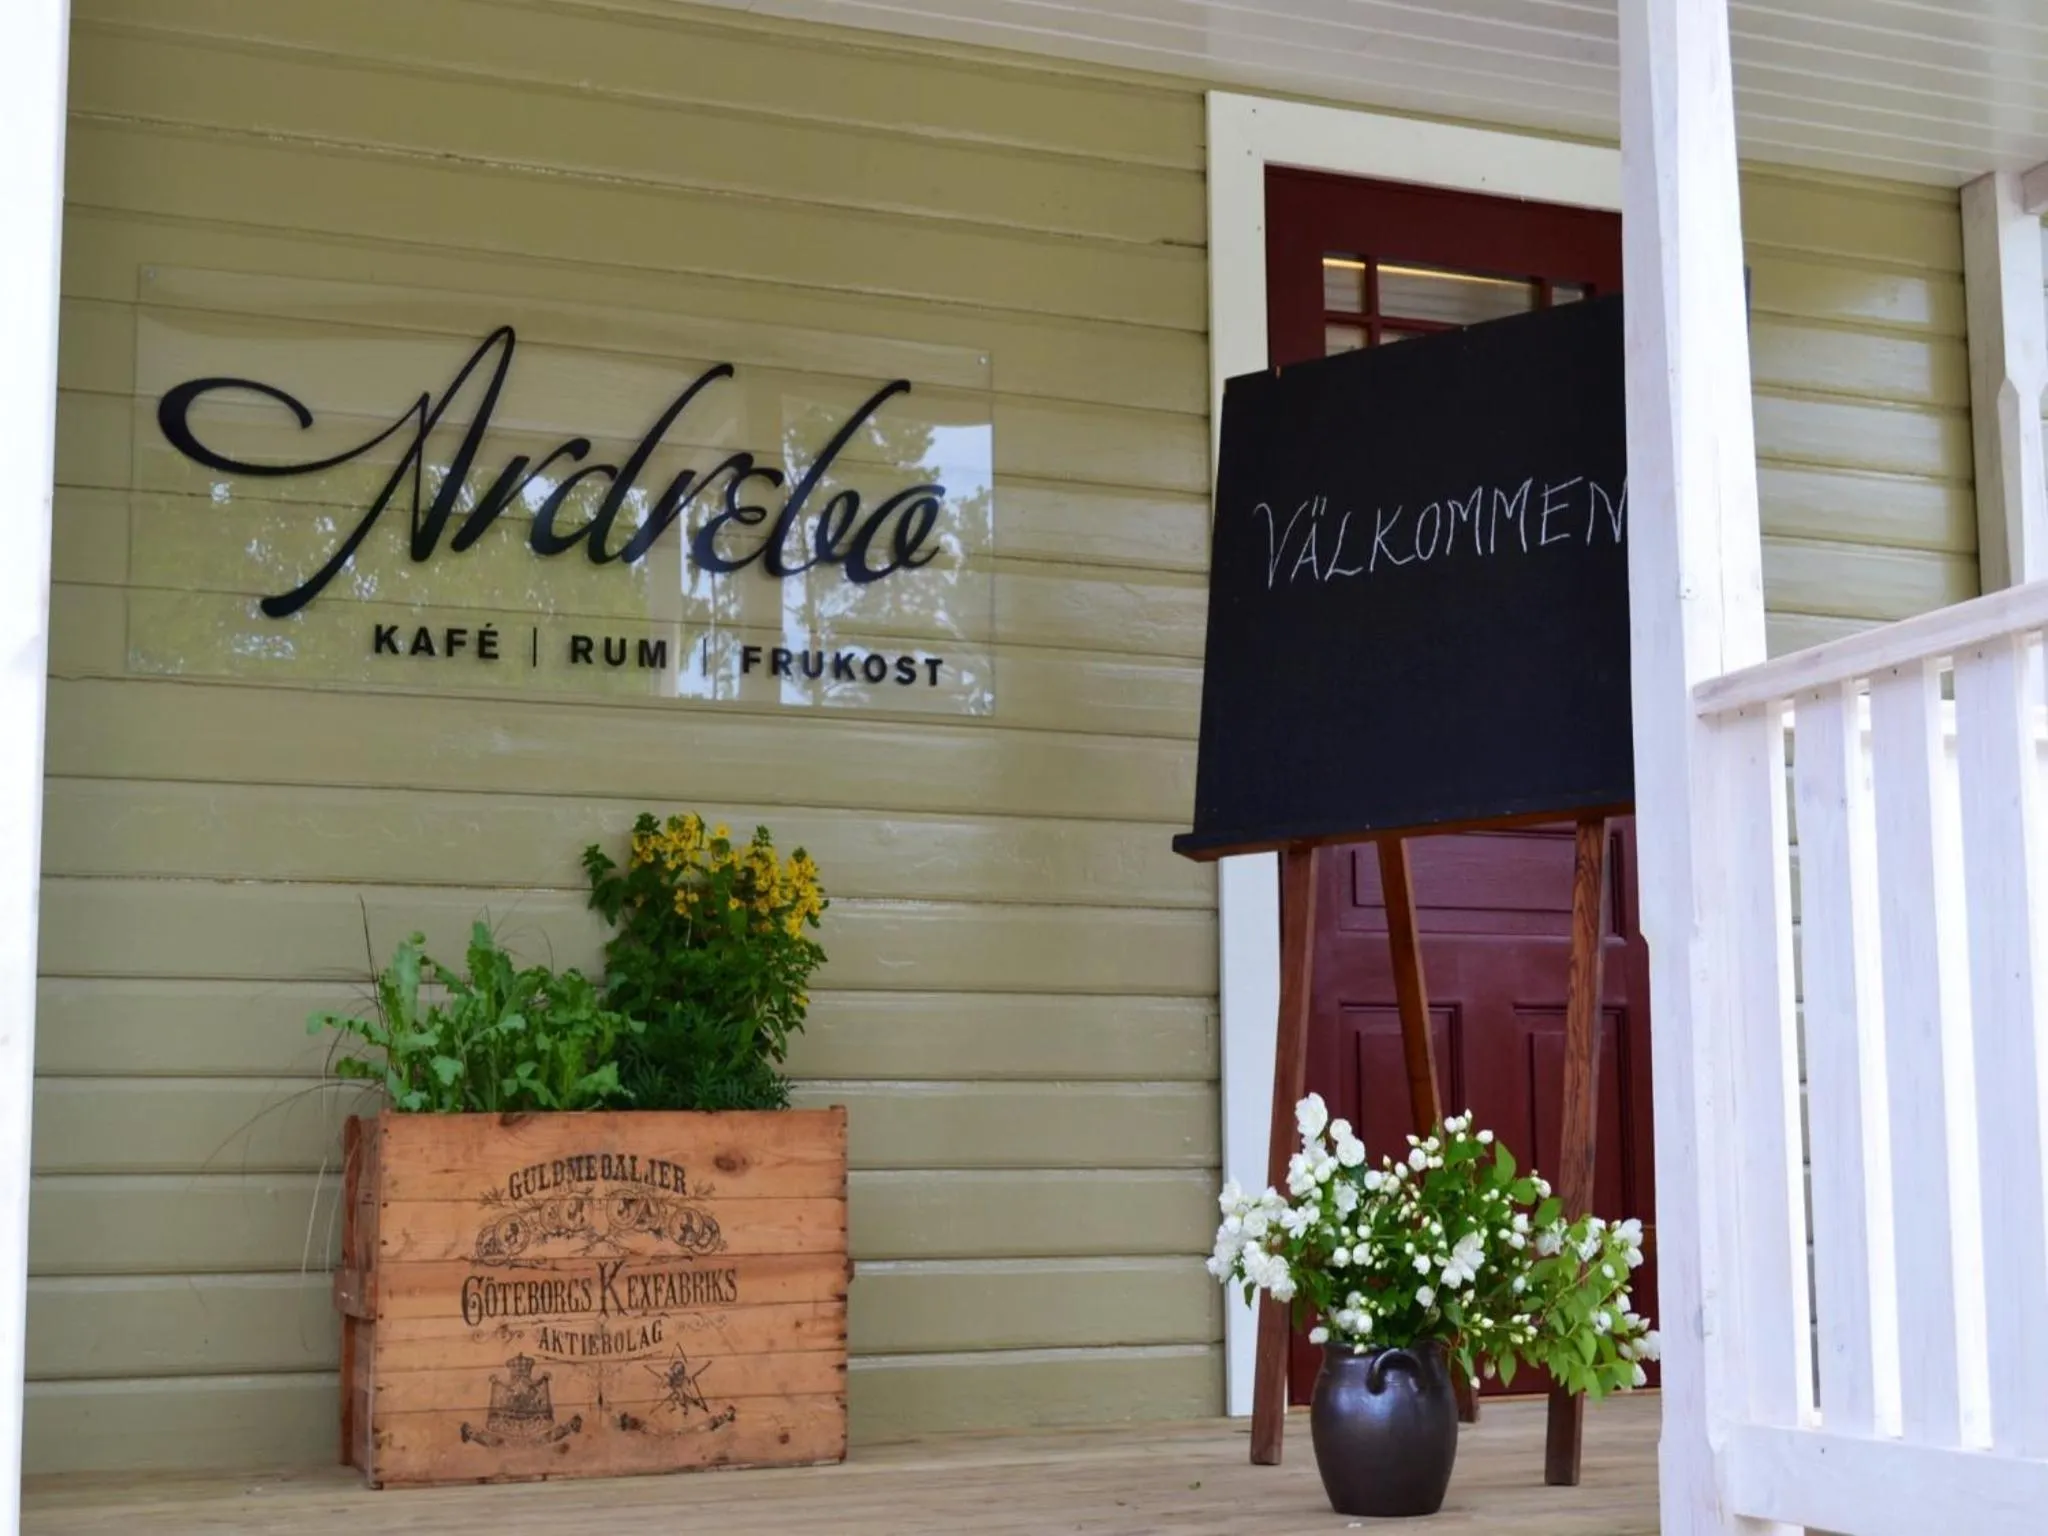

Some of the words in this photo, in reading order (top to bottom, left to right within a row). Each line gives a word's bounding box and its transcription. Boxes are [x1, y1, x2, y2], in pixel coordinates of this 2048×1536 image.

[1253, 475, 1628, 590] VÄLKOMMEN
[373, 622, 500, 660] KAFÉ
[571, 635, 668, 669] RUM
[741, 646, 944, 687] FRUKOST
[508, 1153, 687, 1201] GULDMEDALJER
[461, 1275, 593, 1327] GÖTEBORGS
[596, 1259, 738, 1318] KEXFABRIKS
[538, 1319, 664, 1357] AKTIEBOLAG
